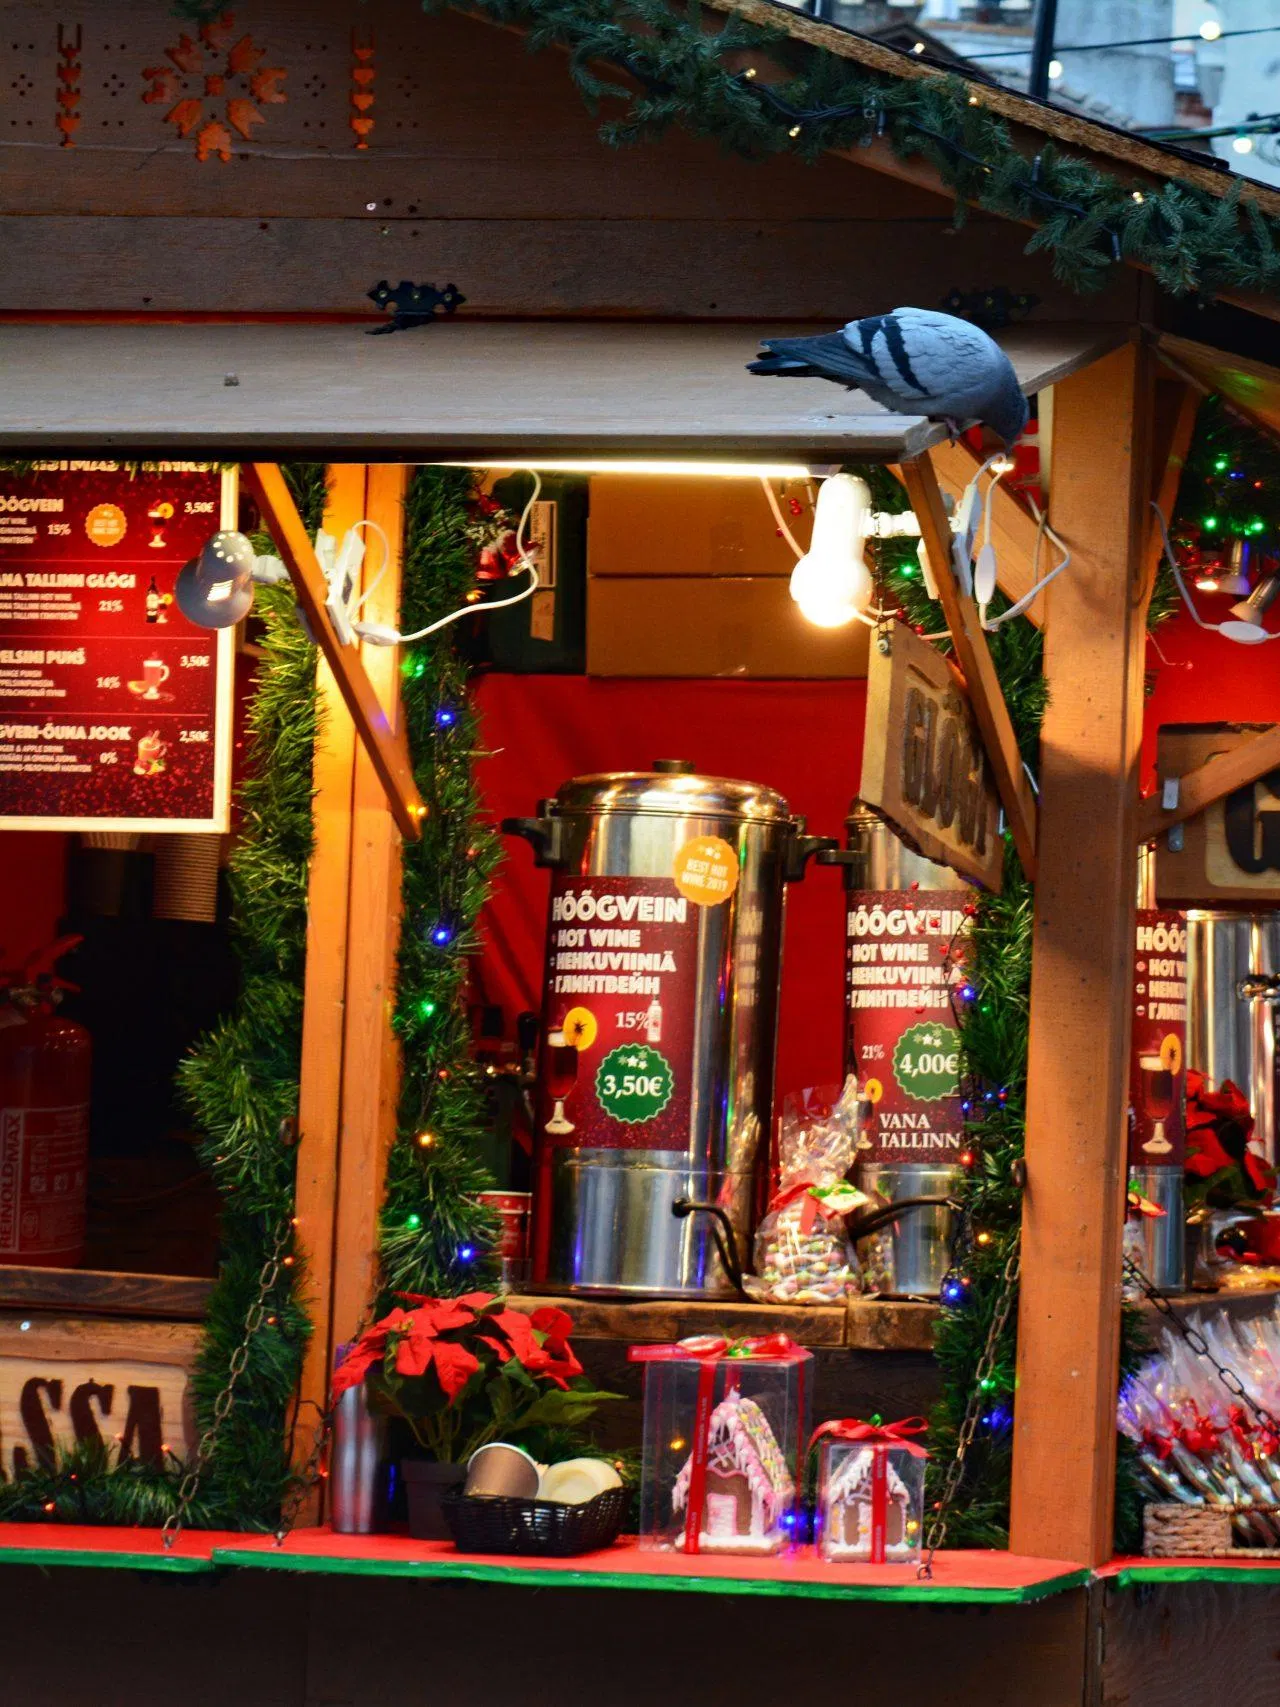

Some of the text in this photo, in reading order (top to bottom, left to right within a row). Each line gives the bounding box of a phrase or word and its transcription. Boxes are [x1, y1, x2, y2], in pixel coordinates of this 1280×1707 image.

[184, 502, 214, 513] 3,50€
[25, 573, 85, 588] TALLINN
[180, 655, 210, 668] 3,50€
[88, 726, 132, 741] JOOK
[179, 730, 210, 743] 2,50€
[552, 889, 687, 923] HÕÕGVEIN
[557, 929, 641, 948] HOT WINE
[556, 951, 677, 972] HEHKUVIINIÄ
[852, 943, 929, 962] HOT WINE
[1149, 958, 1175, 977] HOT
[555, 972, 660, 994] ГЛИНТВЕЙН
[615, 1011, 650, 1030] 15%
[861, 1044, 885, 1060] 21%
[900, 1053, 959, 1077] 4,00€
[603, 1075, 663, 1099] 3,50€
[880, 1113, 930, 1129] VANA
[879, 1132, 961, 1148] TALLINN
[0, 1376, 164, 1478] SSA
